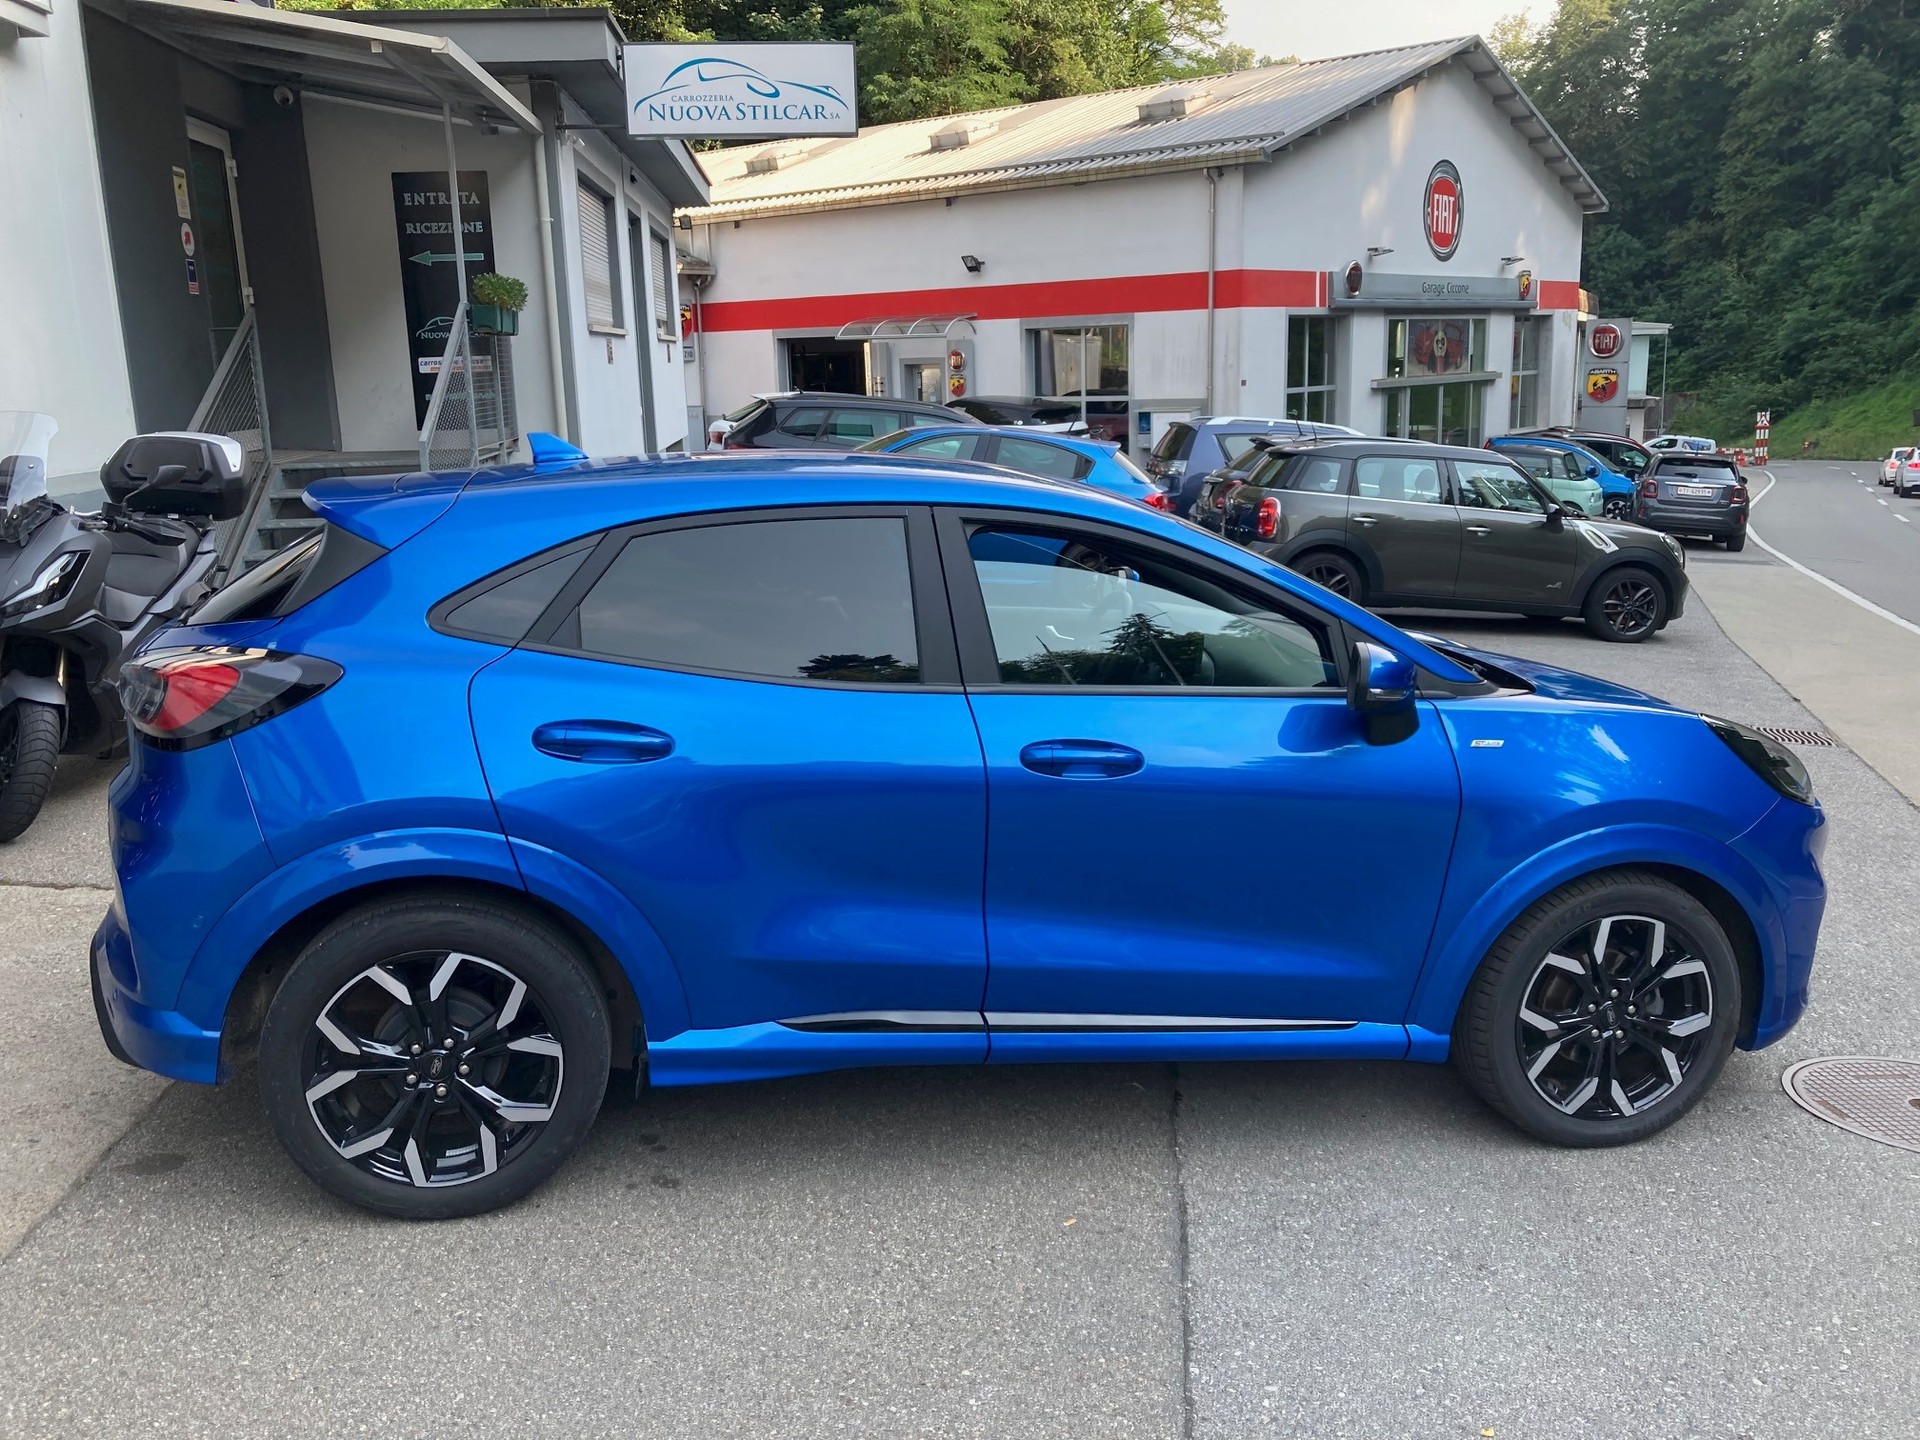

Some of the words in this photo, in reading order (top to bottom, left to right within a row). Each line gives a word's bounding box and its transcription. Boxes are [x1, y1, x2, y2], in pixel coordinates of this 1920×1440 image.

[671, 95, 734, 103] CARROZZERIA
[648, 103, 732, 122] NUOVA
[735, 102, 829, 121] STILCAR
[829, 112, 841, 120] SA
[403, 192, 480, 206] ENTRTA
[1433, 193, 1455, 235] FIAT
[405, 221, 483, 234] RICEZINE
[1421, 282, 1446, 296] Garage
[1446, 282, 1470, 294] Ciccone
[1594, 333, 1616, 349] FIAT
